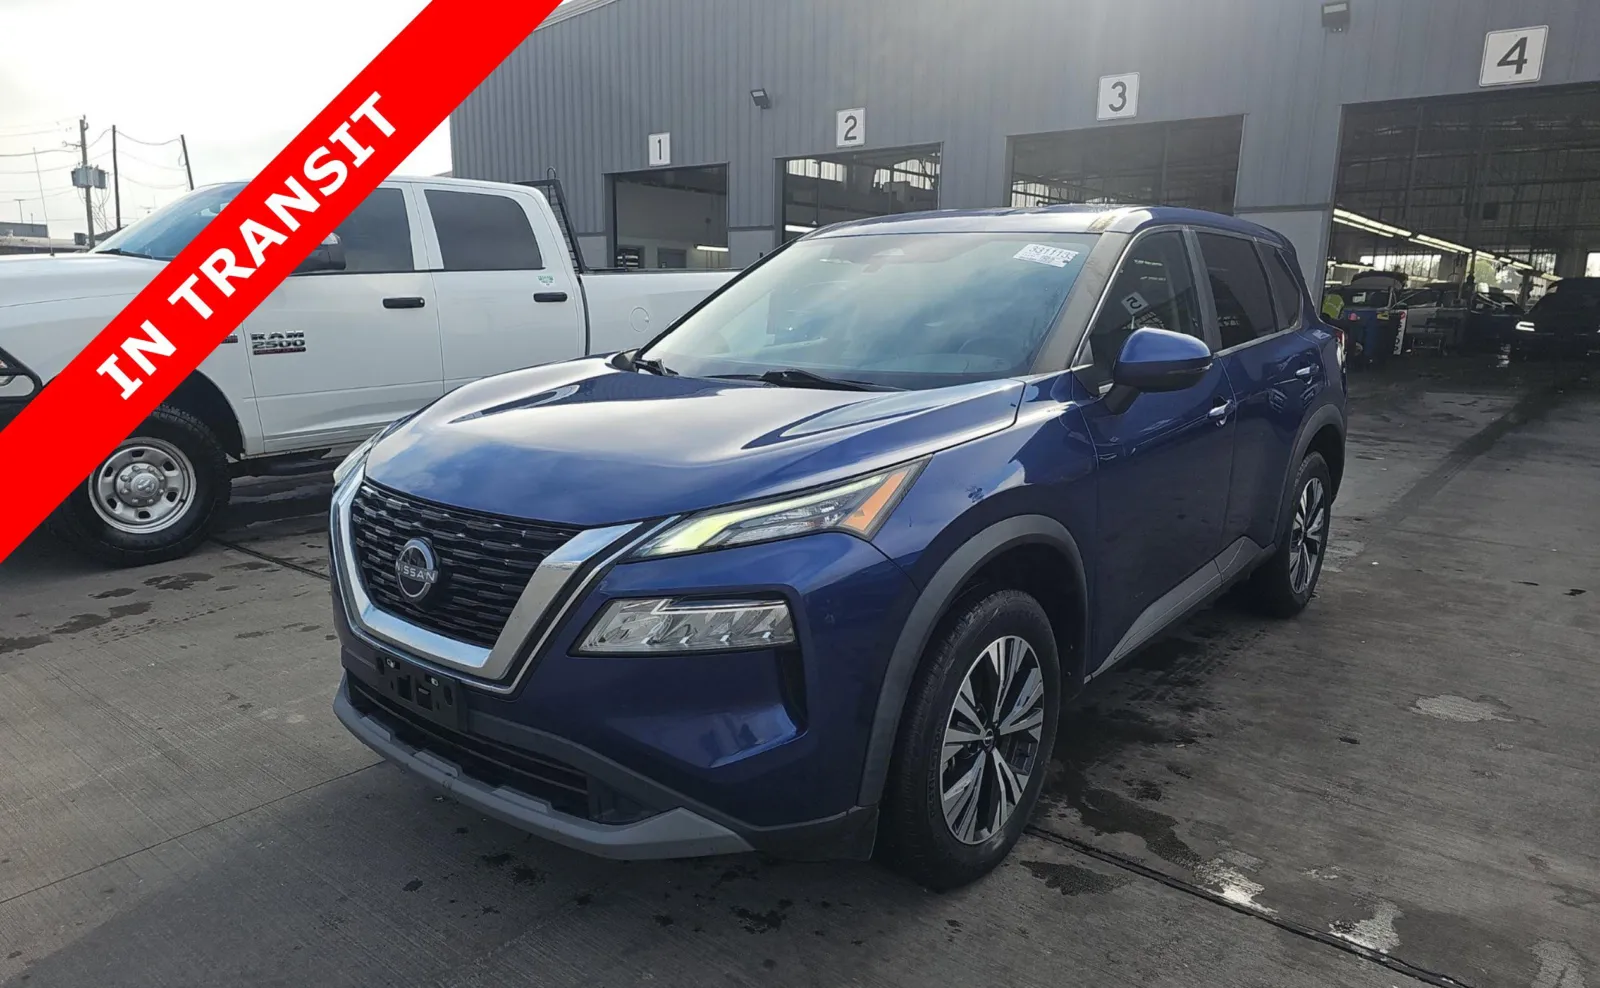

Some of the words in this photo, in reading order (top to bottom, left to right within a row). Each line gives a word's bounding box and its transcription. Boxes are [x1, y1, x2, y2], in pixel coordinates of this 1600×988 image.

[1496, 36, 1528, 75] 4
[1108, 81, 1128, 113] 3
[843, 115, 858, 142] 2
[656, 137, 663, 161] 1
[250, 330, 304, 340] RAM
[252, 339, 305, 349] 2500
[395, 559, 436, 582] NISSAN
